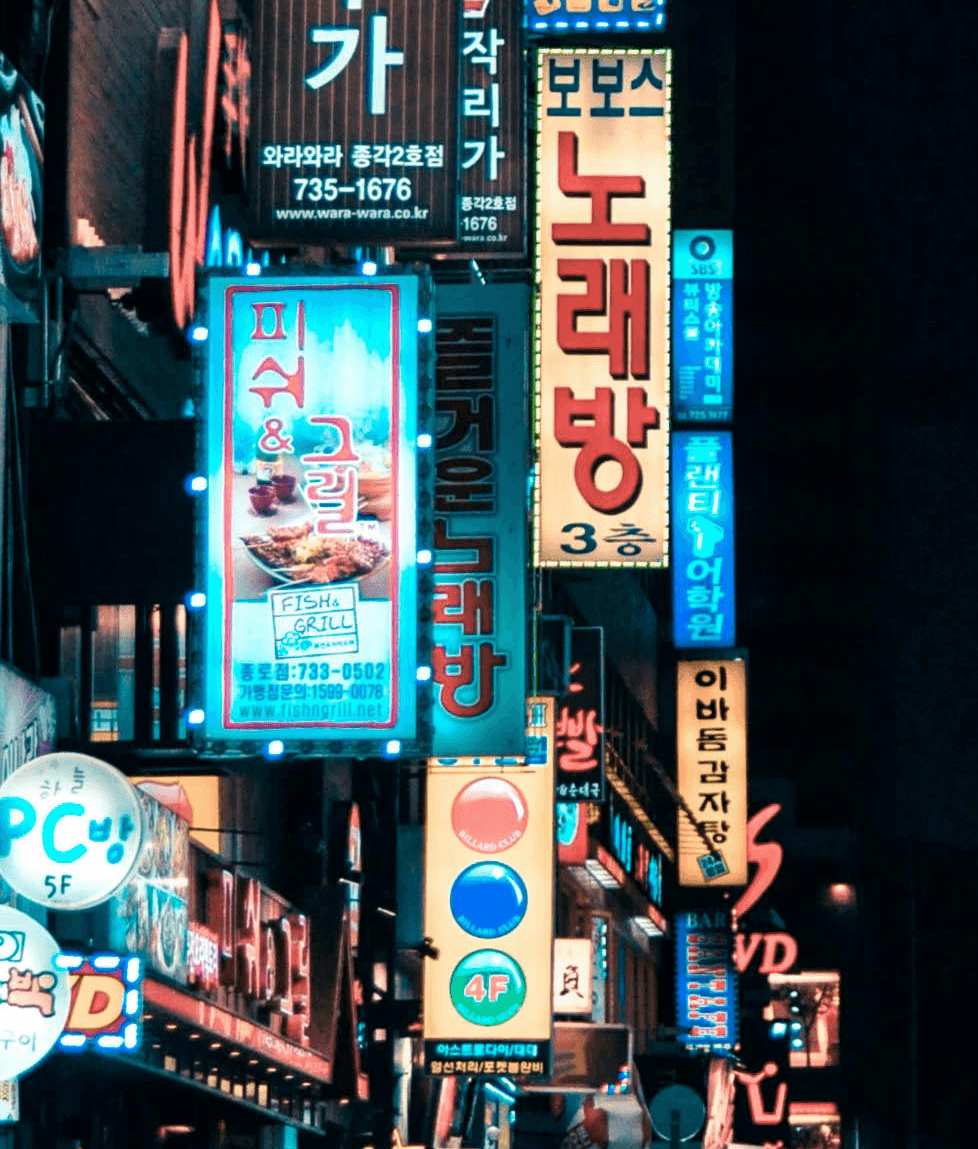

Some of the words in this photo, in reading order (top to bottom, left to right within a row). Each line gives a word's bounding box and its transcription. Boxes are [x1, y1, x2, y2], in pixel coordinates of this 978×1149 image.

[547, 58, 664, 117] 보보스
[263, 145, 343, 168] 와라와라
[351, 145, 444, 168] 종각2호점
[294, 178, 411, 200] 735-1676
[276, 206, 429, 220] www.wara-wara.co.kr
[461, 196, 517, 211] 종각2호점
[551, 131, 660, 516] 노래방
[560, 522, 655, 556] 3층
[294, 615, 354, 634] GRILL
[239, 662, 386, 682] 종로점:733-0502
[239, 704, 384, 718] www.fishngrill.net
[694, 666, 730, 845] 이바돔감자탕
[0, 796, 135, 864] PC방
[45, 875, 73, 899] 5F
[465, 974, 510, 1003] 4F
